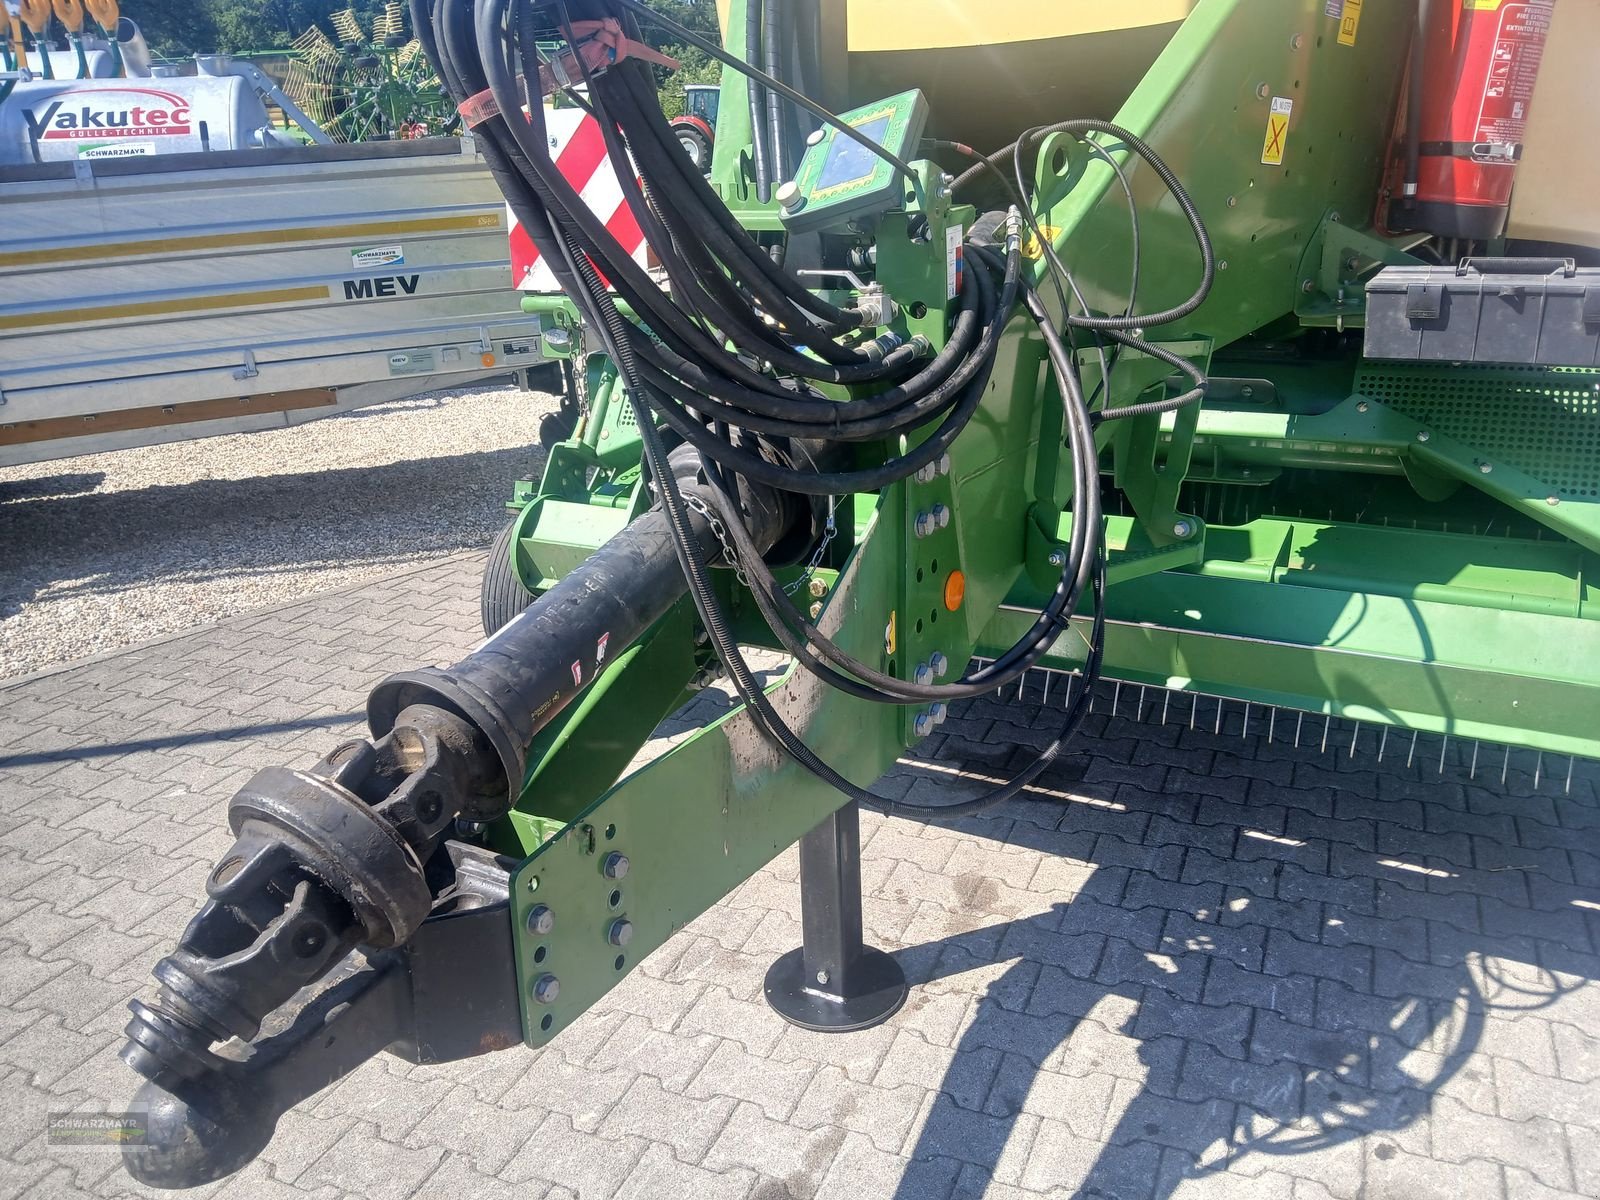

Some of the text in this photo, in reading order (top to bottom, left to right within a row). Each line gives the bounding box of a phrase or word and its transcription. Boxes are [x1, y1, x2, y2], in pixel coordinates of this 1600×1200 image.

[22, 101, 191, 139] Vakutec
[85, 148, 145, 157] SCHWARZMAYR
[343, 275, 420, 300] MEV
